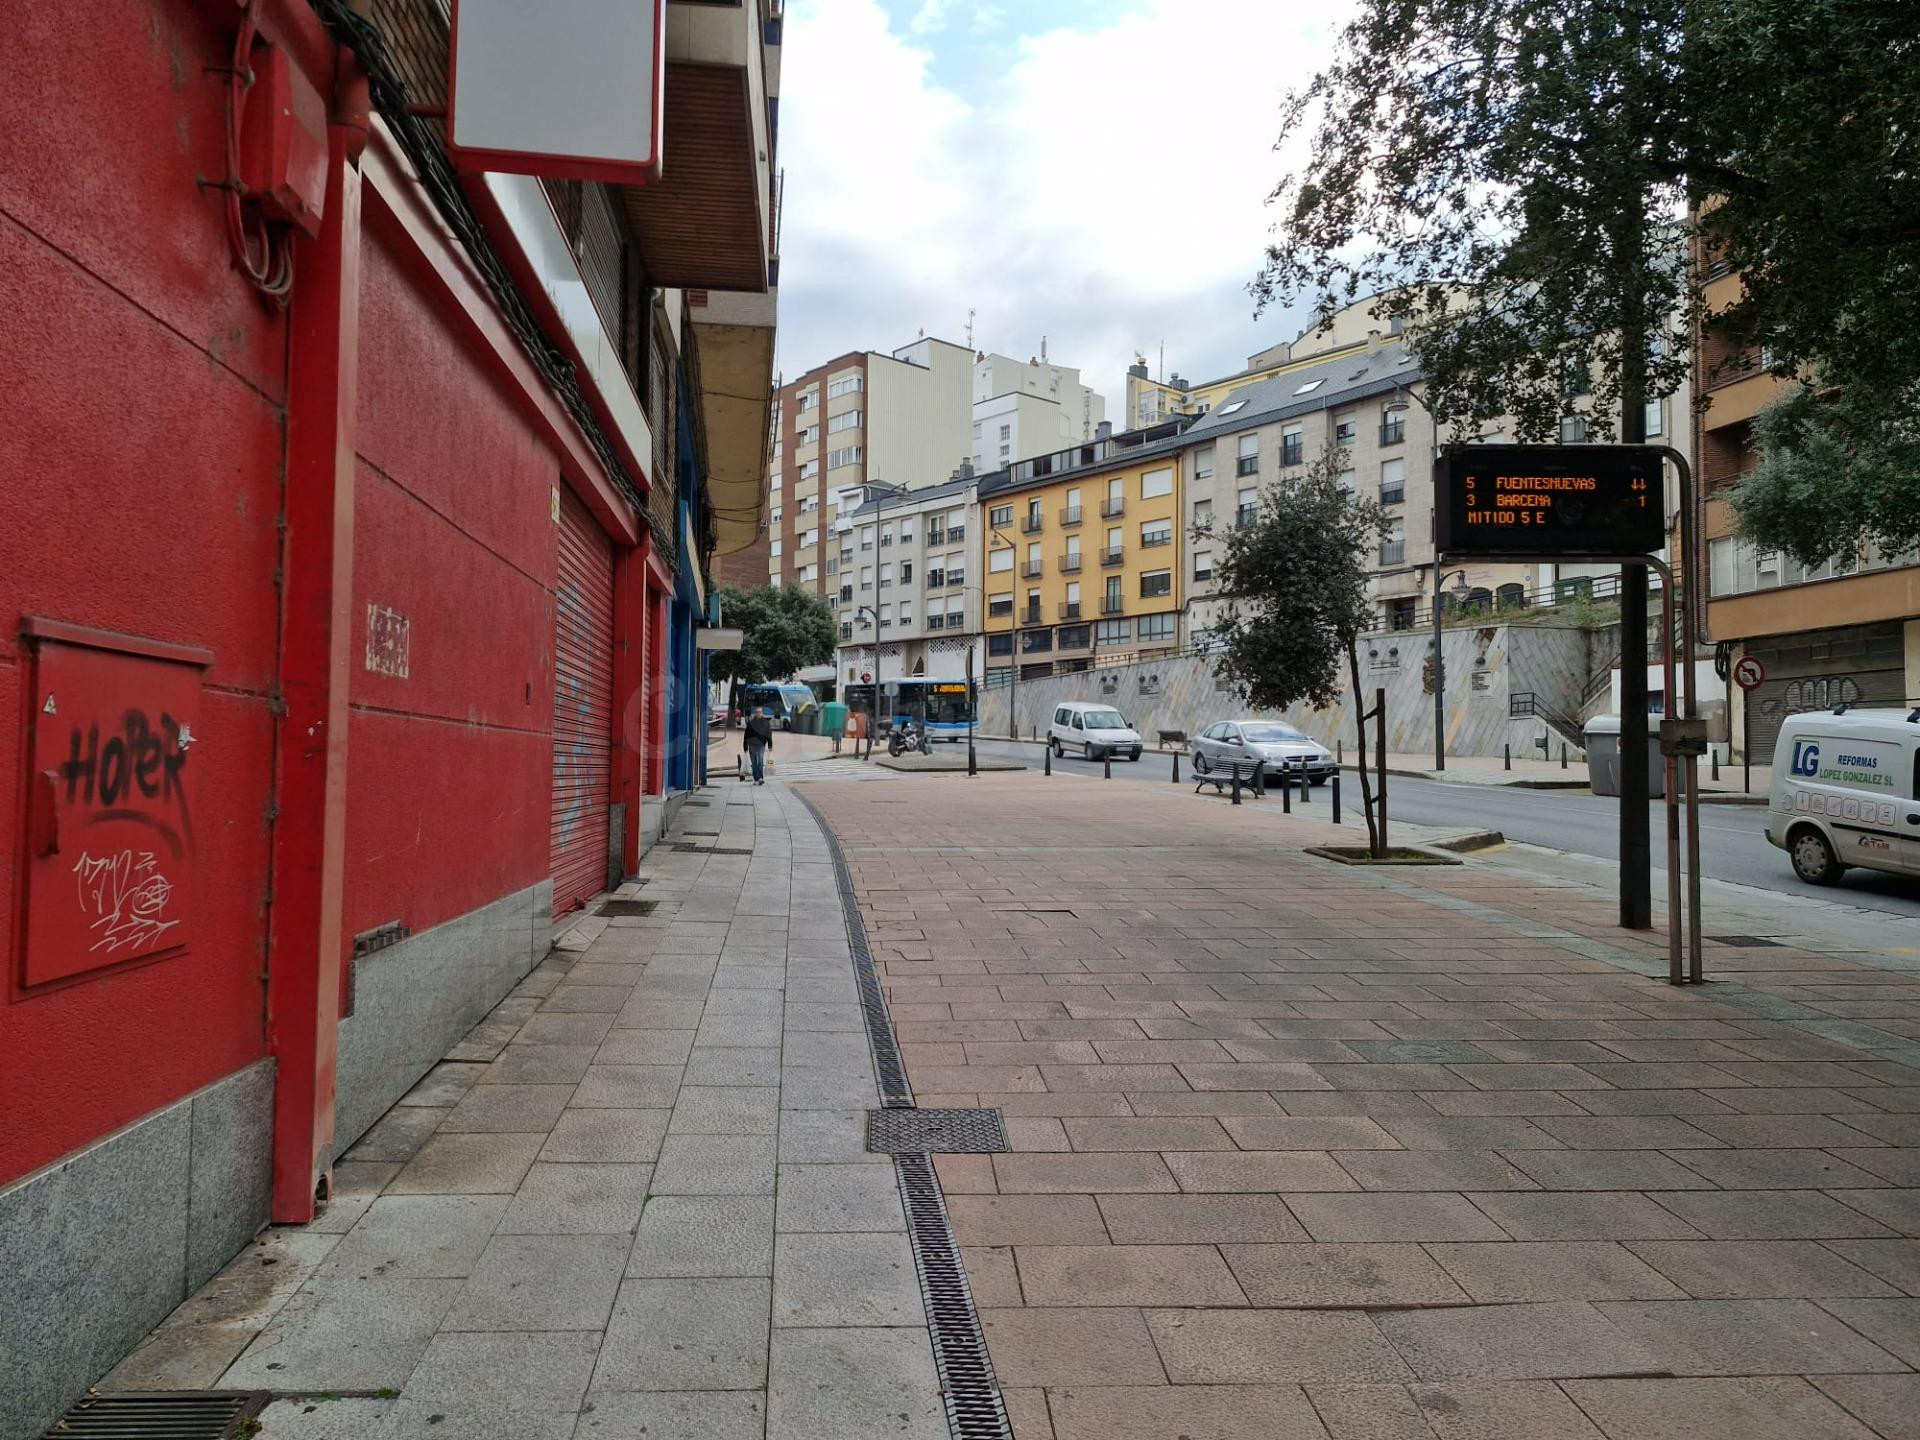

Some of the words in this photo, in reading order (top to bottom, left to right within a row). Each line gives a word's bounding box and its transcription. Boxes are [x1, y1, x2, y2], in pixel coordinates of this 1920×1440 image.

[1466, 476, 1476, 490] 5
[1496, 477, 1596, 490] FUENTESNUEVAS
[1466, 496, 1476, 508] 3
[1496, 496, 1552, 508] BARCENA
[1638, 496, 1646, 508] 1
[1468, 511, 1515, 524] MITIDO
[1536, 511, 1545, 524] E
[1792, 742, 1820, 777] LG
[1837, 754, 1878, 769] REFORMAS
[1820, 768, 1842, 781] LOPEZ
[1843, 771, 1883, 786] GONZALEZ
[1884, 775, 1894, 787] SL
